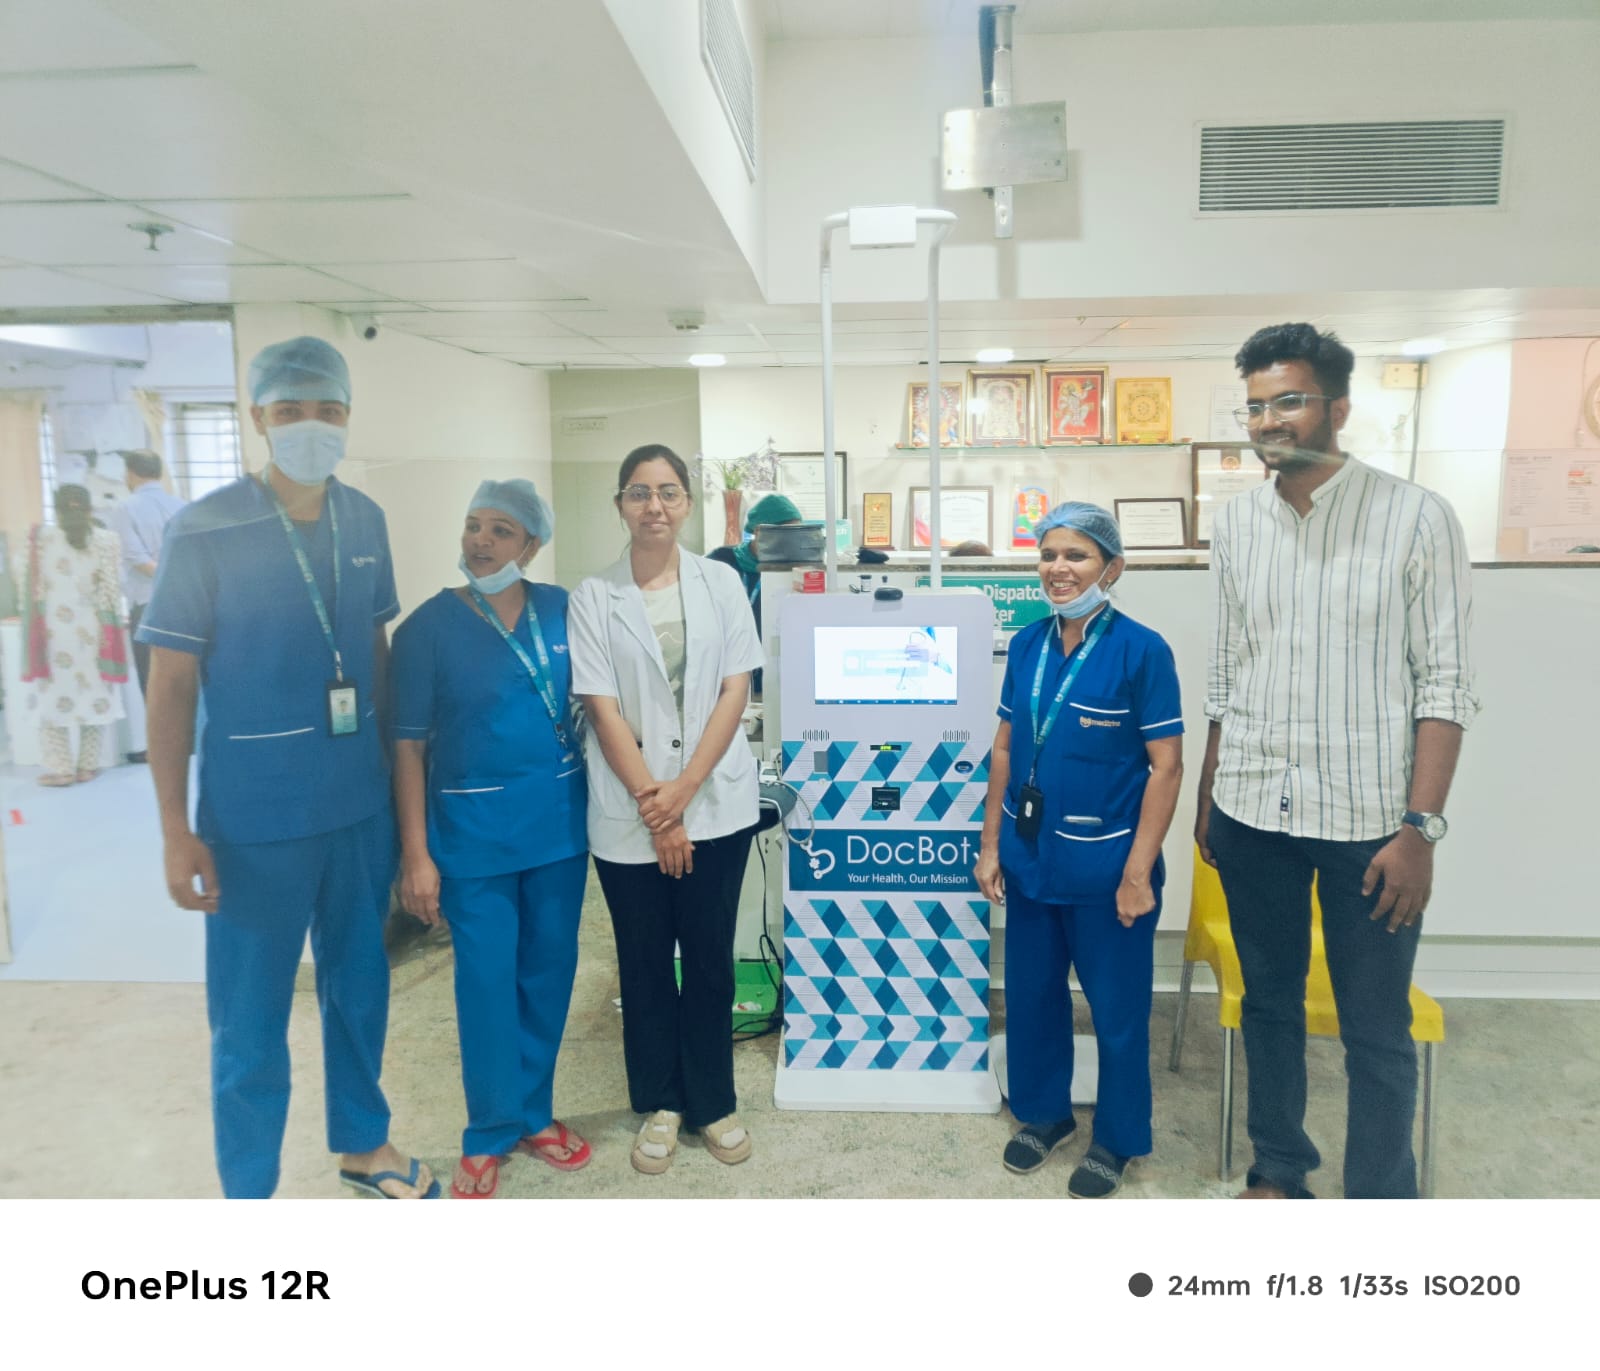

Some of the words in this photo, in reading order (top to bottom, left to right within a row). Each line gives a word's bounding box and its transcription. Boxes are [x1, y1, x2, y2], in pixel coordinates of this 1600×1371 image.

[983, 584, 1041, 605] Dispatc
[847, 835, 971, 865] DocBot
[848, 873, 870, 884] Your
[872, 873, 907, 885] Health,
[909, 873, 928, 884] Our
[930, 873, 968, 884] Mission
